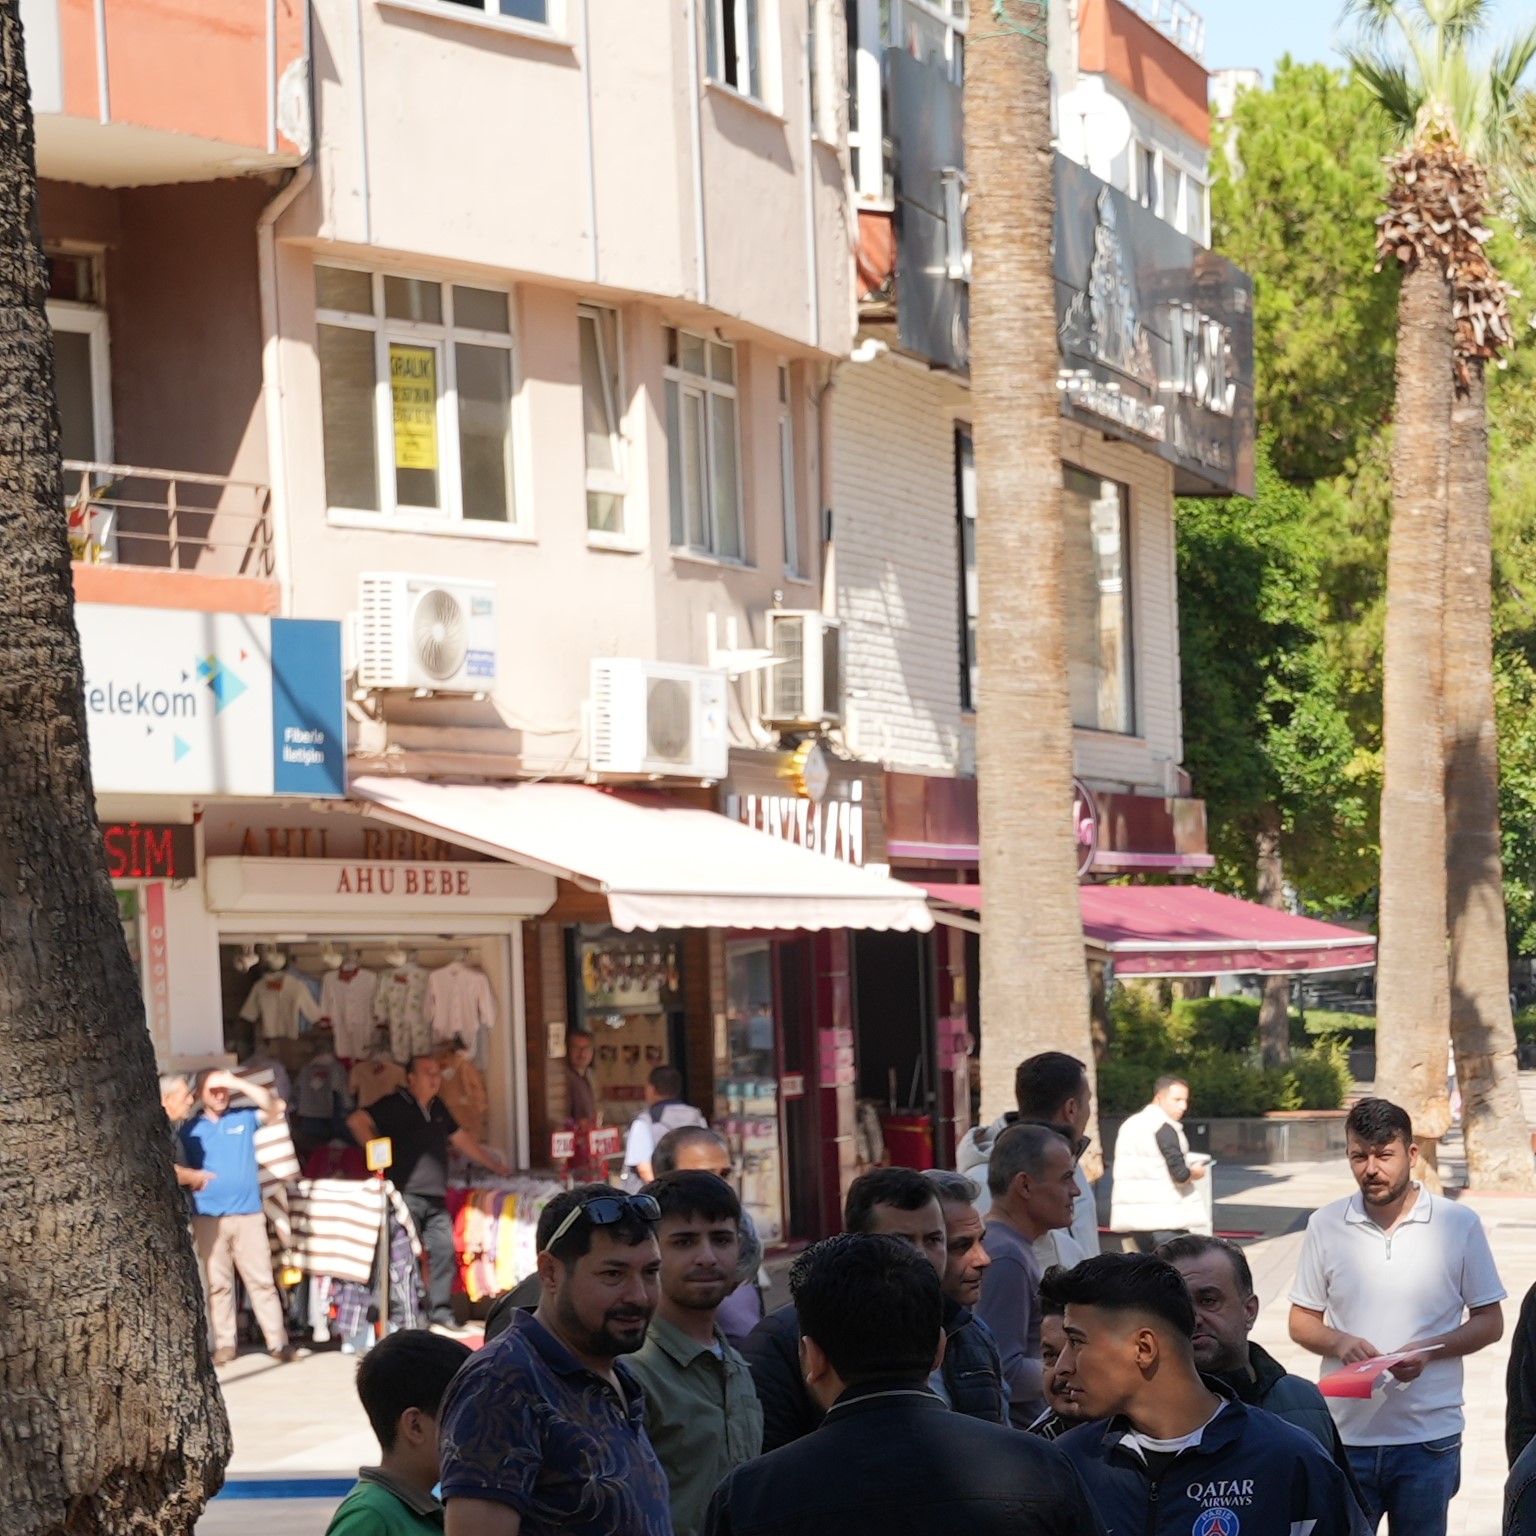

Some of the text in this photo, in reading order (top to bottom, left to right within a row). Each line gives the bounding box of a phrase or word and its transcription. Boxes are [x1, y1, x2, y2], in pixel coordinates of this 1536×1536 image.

[85, 679, 197, 719] elekom
[336, 868, 471, 896] AHU BEBE
[1186, 1479, 1255, 1502] QATAR
[1200, 1495, 1253, 1508] AIRWAYS
[1201, 1509, 1233, 1521] PARIS
